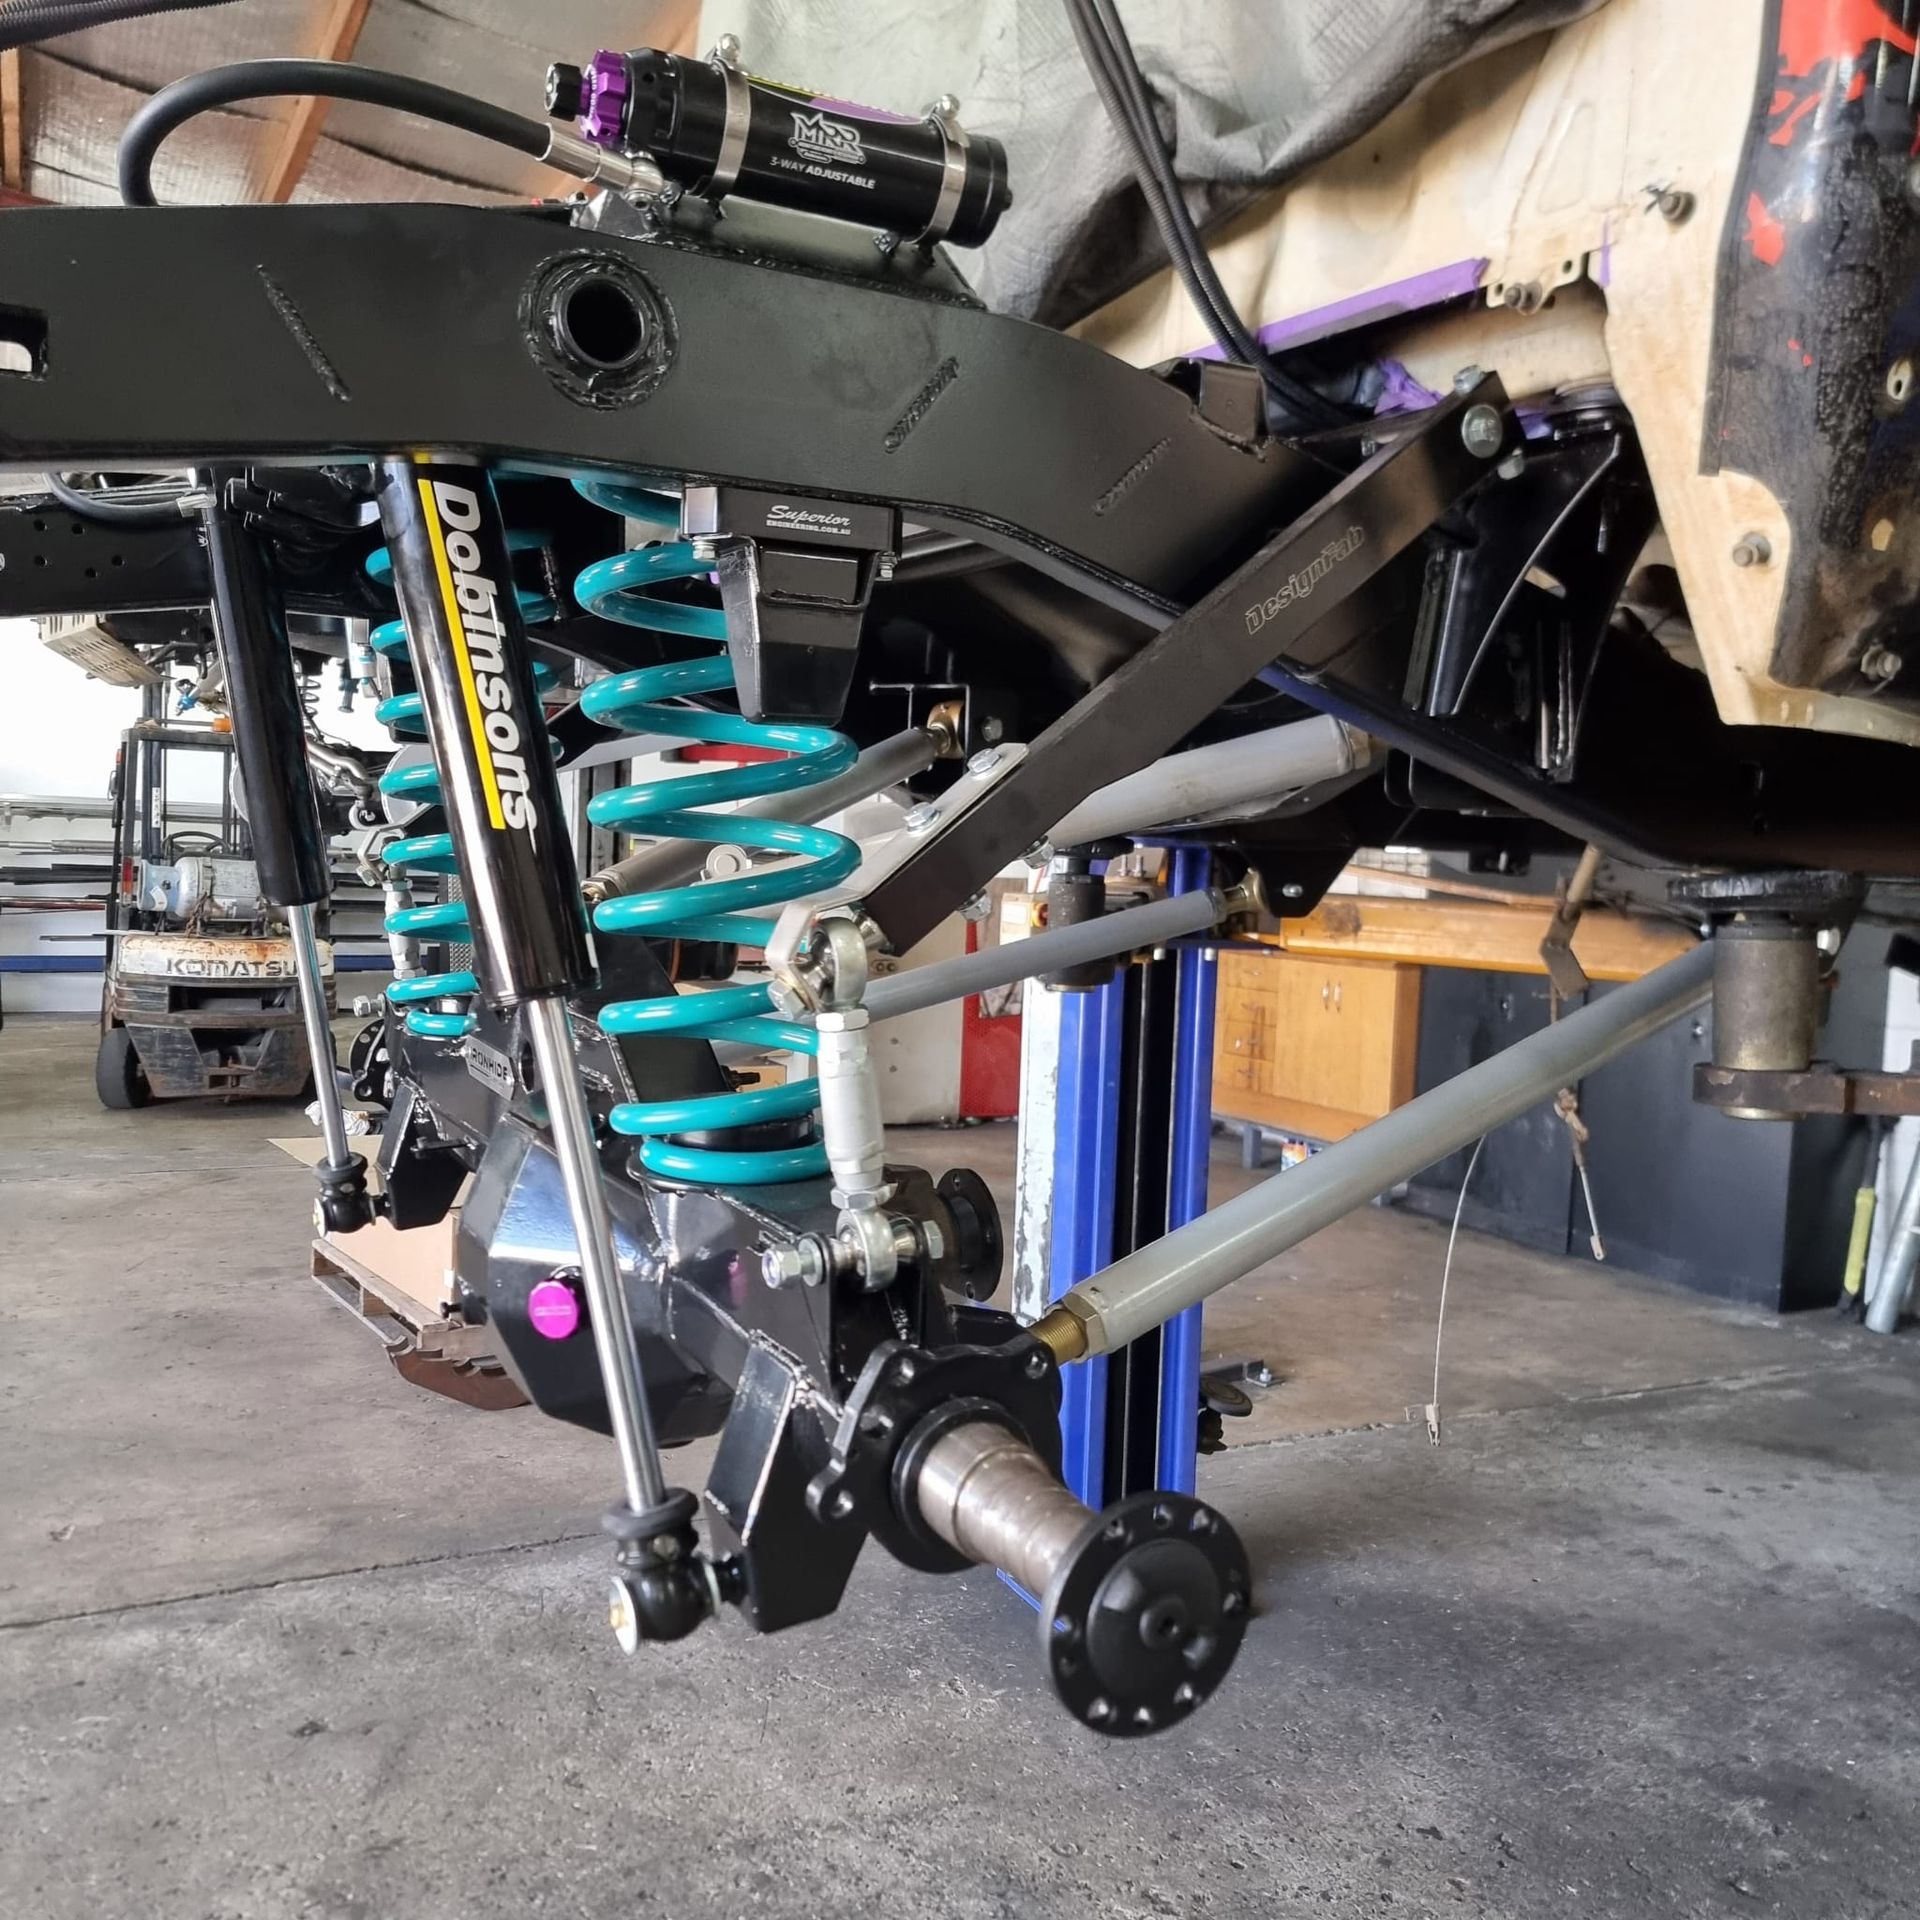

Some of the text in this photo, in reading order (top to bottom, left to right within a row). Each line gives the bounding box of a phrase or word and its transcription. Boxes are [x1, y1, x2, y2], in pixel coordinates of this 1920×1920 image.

[769, 156, 875, 189] 3-WAY ADJUSTABLE
[766, 519, 851, 535] ENGINEERING.COM.AU
[767, 505, 851, 526] Superior
[1245, 526, 1365, 635] DesignFab
[432, 480, 538, 831] Dobinsons
[167, 959, 299, 977] KOMATSU
